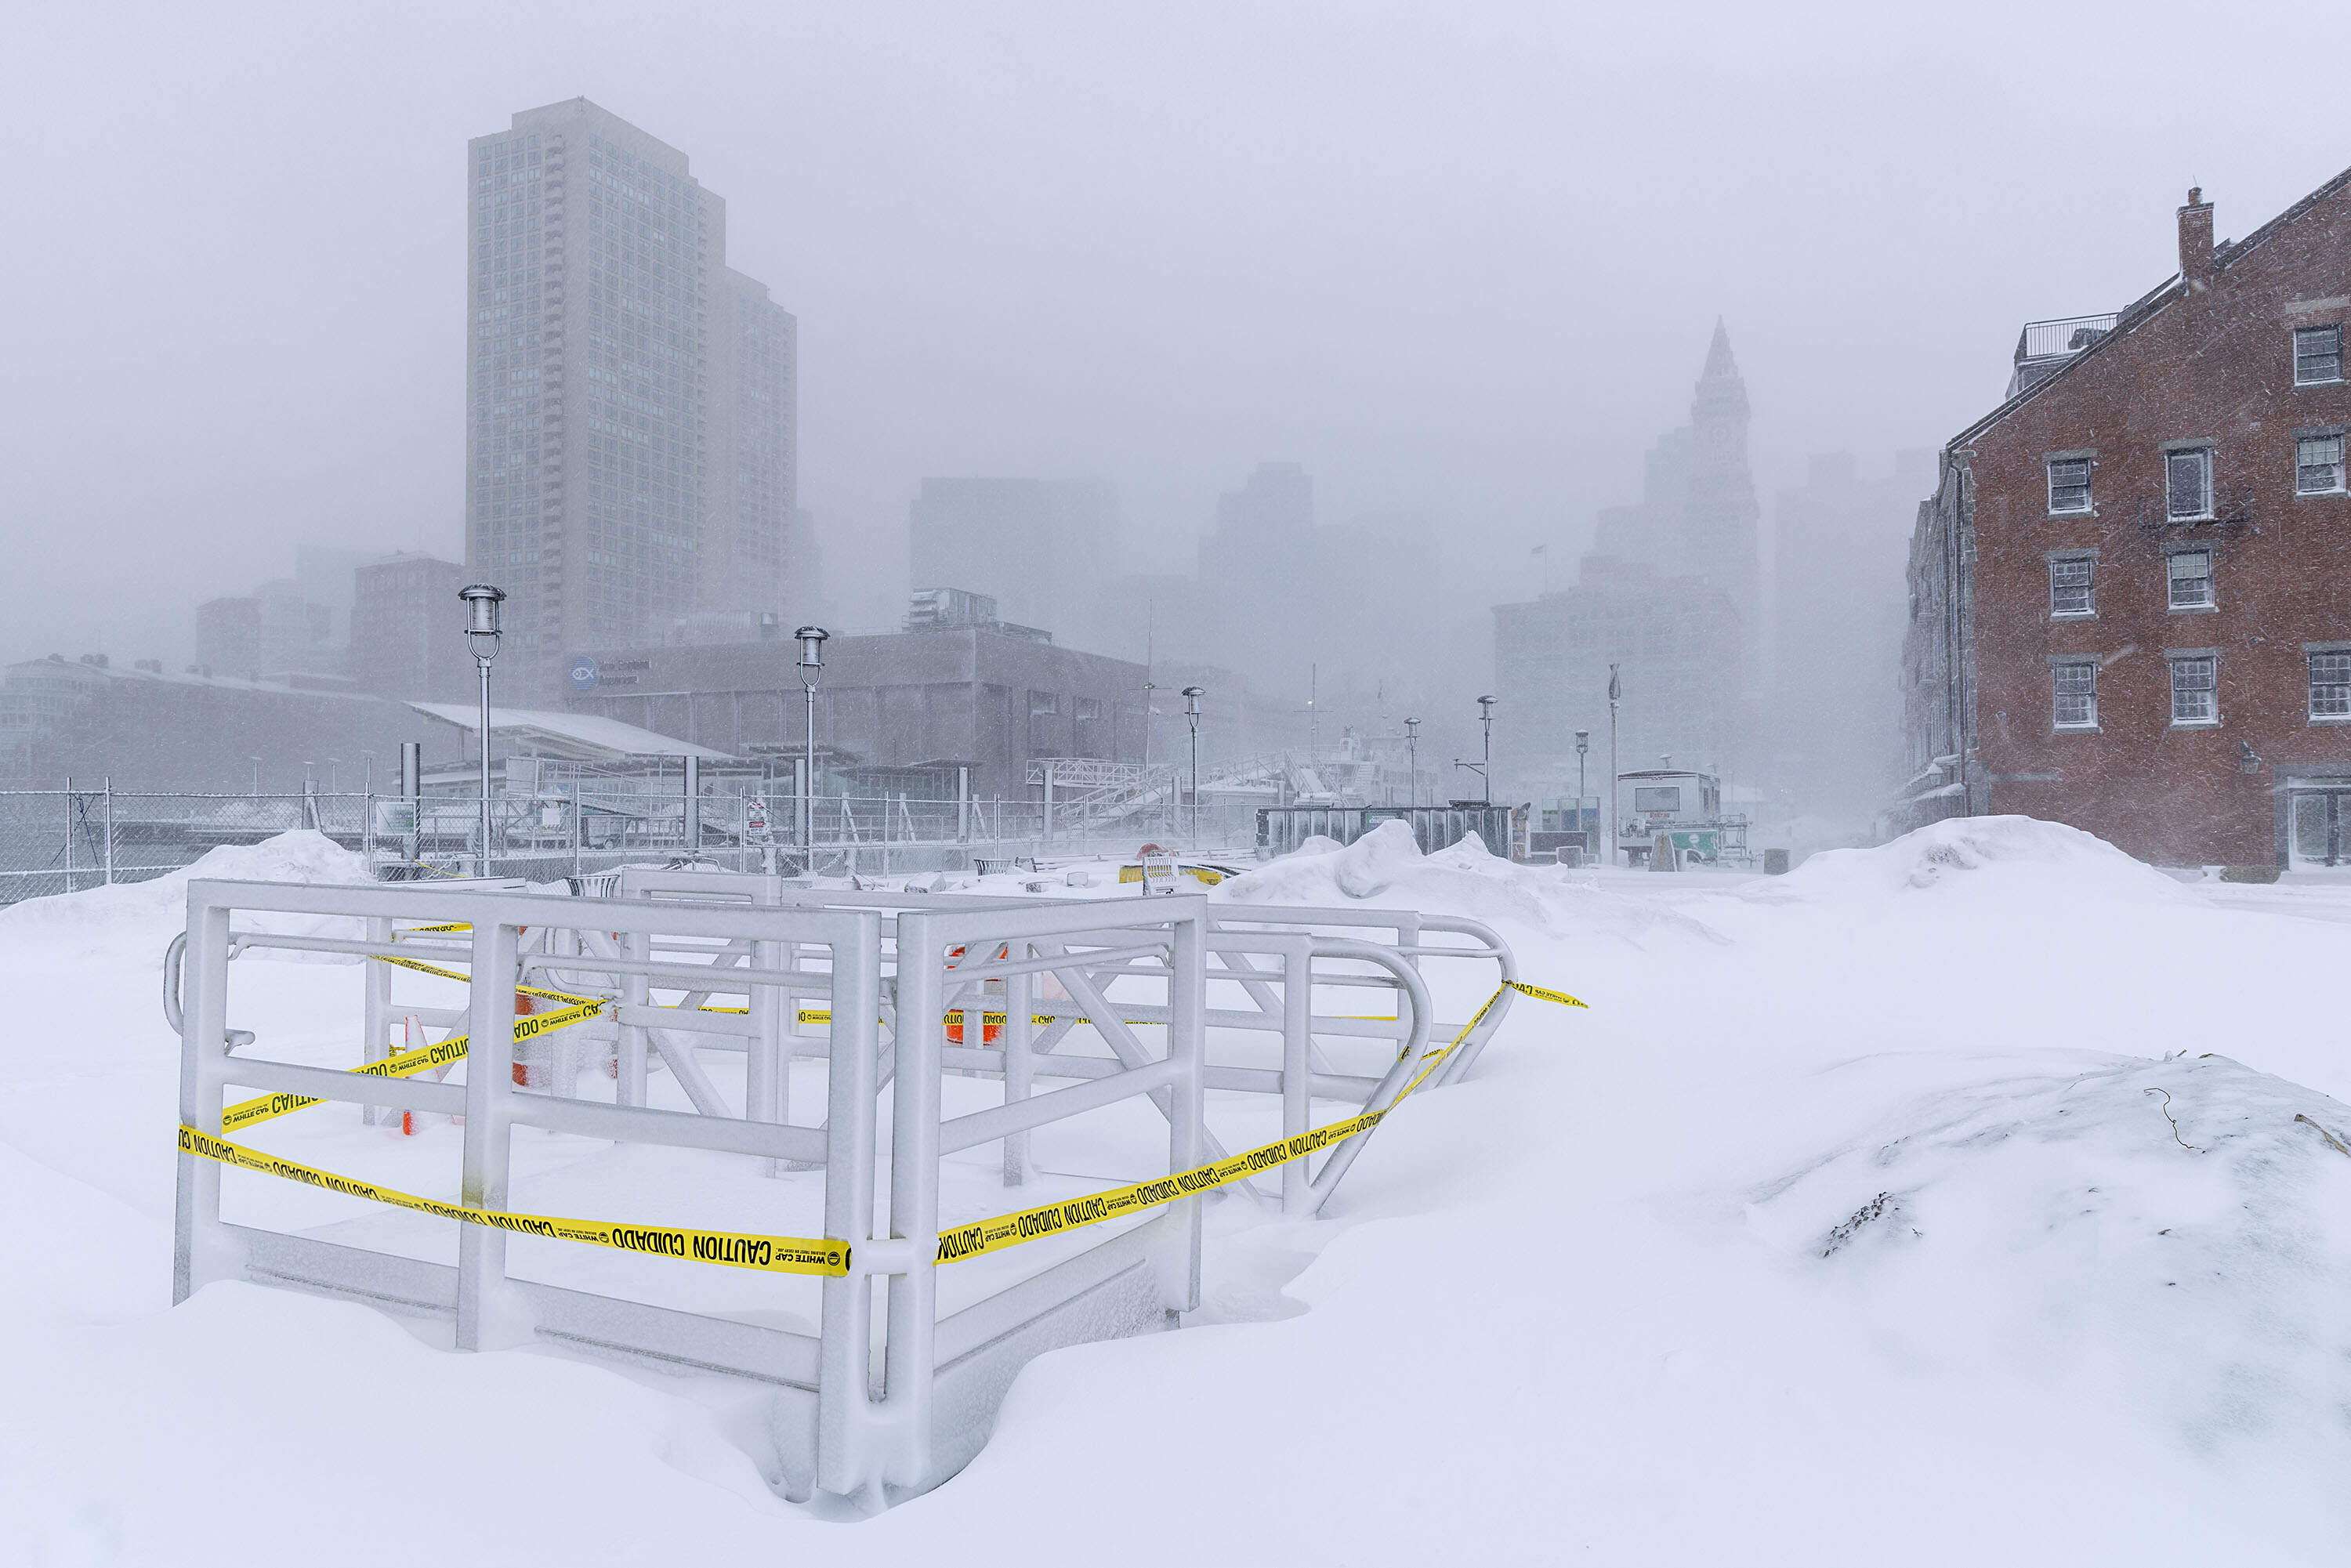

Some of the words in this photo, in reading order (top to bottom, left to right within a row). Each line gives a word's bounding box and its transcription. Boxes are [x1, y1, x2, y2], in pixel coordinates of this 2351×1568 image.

[194, 1135, 237, 1164] CAUTION
[1289, 1130, 1327, 1157] CAUTION
[1247, 1143, 1287, 1171] CUIDADO
[273, 1161, 324, 1188] CUIDADO
[1177, 1167, 1220, 1192] CAUTION
[1229, 1166, 1242, 1175] WHITE
[325, 1176, 382, 1202] CAUTION
[1136, 1179, 1180, 1204] CUIDADO
[423, 1202, 487, 1226] CUIDADO
[1063, 1197, 1107, 1226] CAUTION
[1117, 1199, 1132, 1208] WHITE
[487, 1215, 557, 1238] CAUTION
[994, 1229, 1011, 1240] WHITE
[1018, 1208, 1062, 1238] CUIDADO
[575, 1233, 599, 1242] WHITE
[612, 1228, 685, 1256] CUIDADO
[985, 1233, 994, 1242] CAP
[694, 1235, 771, 1266] CAUTION
[776, 1253, 793, 1262] CAP
[795, 1255, 825, 1264] WHITE
